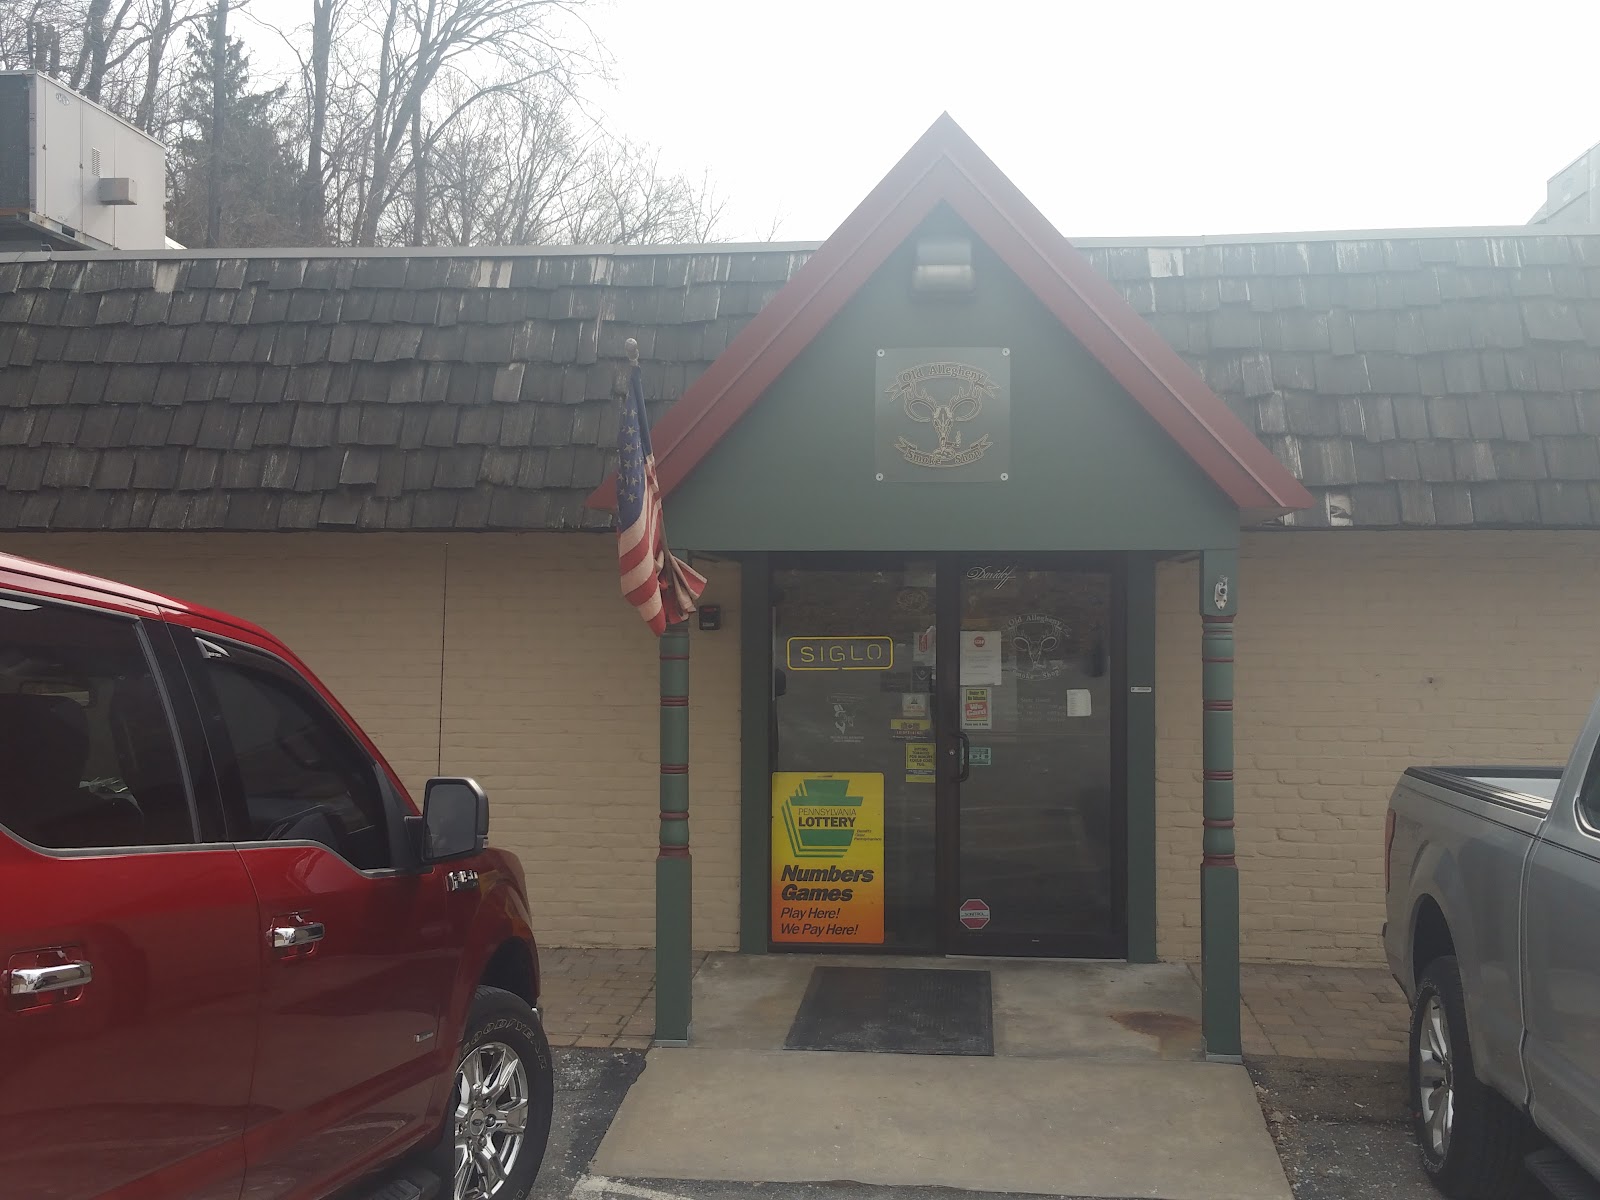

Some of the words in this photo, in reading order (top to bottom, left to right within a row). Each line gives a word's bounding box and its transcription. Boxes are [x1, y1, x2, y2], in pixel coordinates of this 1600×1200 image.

[902, 368, 924, 382] Old
[928, 364, 984, 383] Allegheny
[907, 449, 941, 464] Smoke
[955, 449, 982, 464] Shop
[1008, 616, 1022, 626] Old
[1026, 614, 1062, 627] Allegheny
[800, 643, 882, 663] SIGLO
[1042, 669, 1061, 679] Shop
[798, 808, 857, 816] PENNSYLVANIA
[798, 816, 857, 828] LOTTERY
[781, 864, 874, 882] Numbers
[782, 884, 853, 901] Games
[780, 907, 807, 921] Play
[808, 908, 840, 919] Here!
[781, 923, 800, 934] We
[801, 923, 827, 937] Pay
[826, 924, 859, 935] Here!
